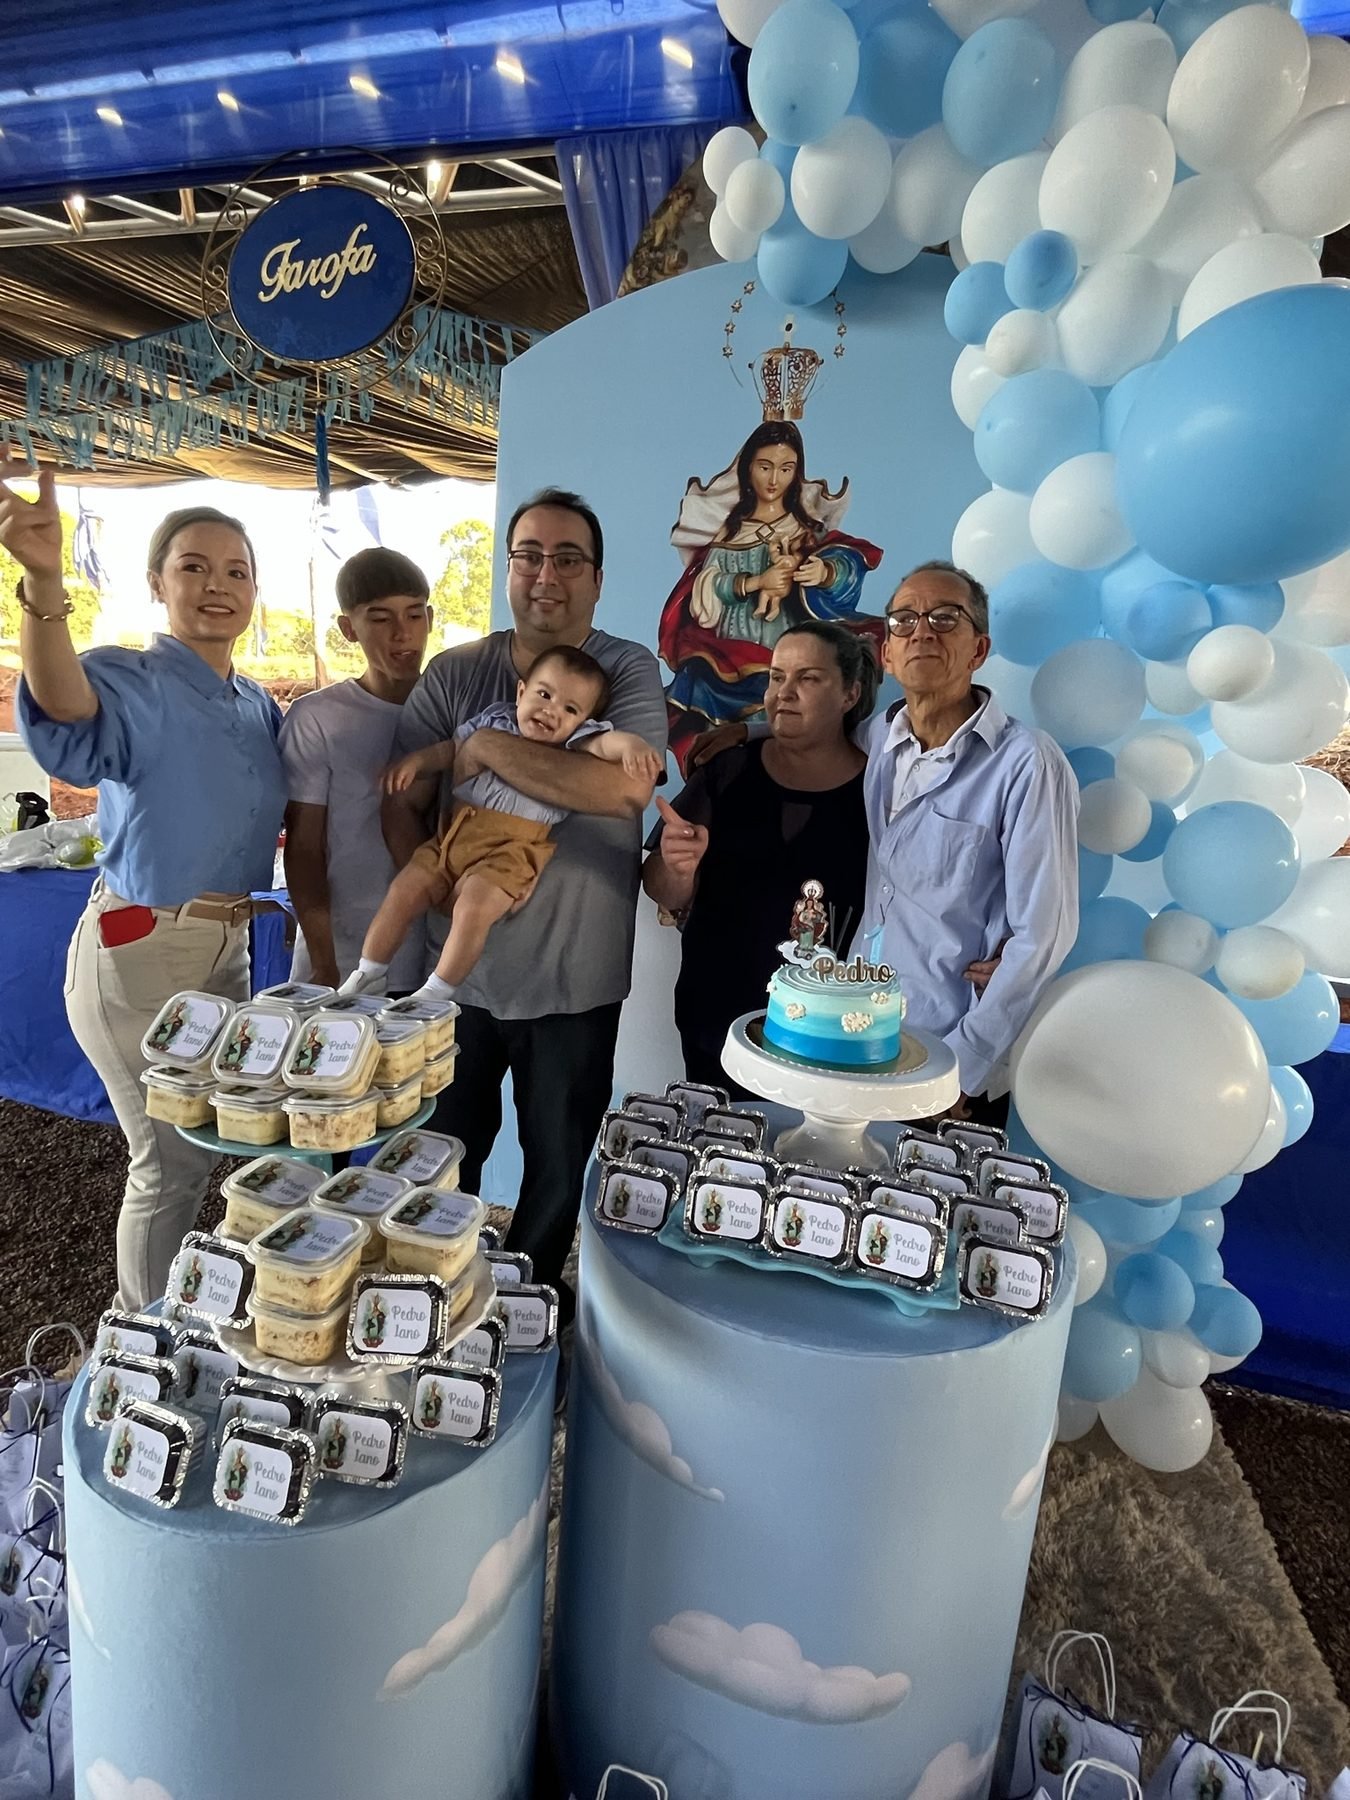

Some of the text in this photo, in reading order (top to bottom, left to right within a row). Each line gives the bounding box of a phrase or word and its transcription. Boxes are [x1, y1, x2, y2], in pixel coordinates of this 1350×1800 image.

[258, 223, 377, 303] Farofa
[813, 956, 895, 984] Pedro
[727, 1200, 758, 1215] Pedro
[808, 1214, 841, 1232] Pedro
[1030, 1218, 1049, 1228] ano
[893, 1233, 927, 1253] Pedro
[208, 1268, 238, 1290] Pedro
[1003, 1265, 1038, 1284] Pedro
[391, 1305, 427, 1322] Pedro
[514, 1309, 543, 1322] Pedro
[460, 1340, 488, 1356] Pedro
[448, 1392, 480, 1410] Pedro
[352, 1430, 386, 1450] Pedro
[137, 1441, 163, 1465] Pedro
[254, 1461, 286, 1484] Pedro
